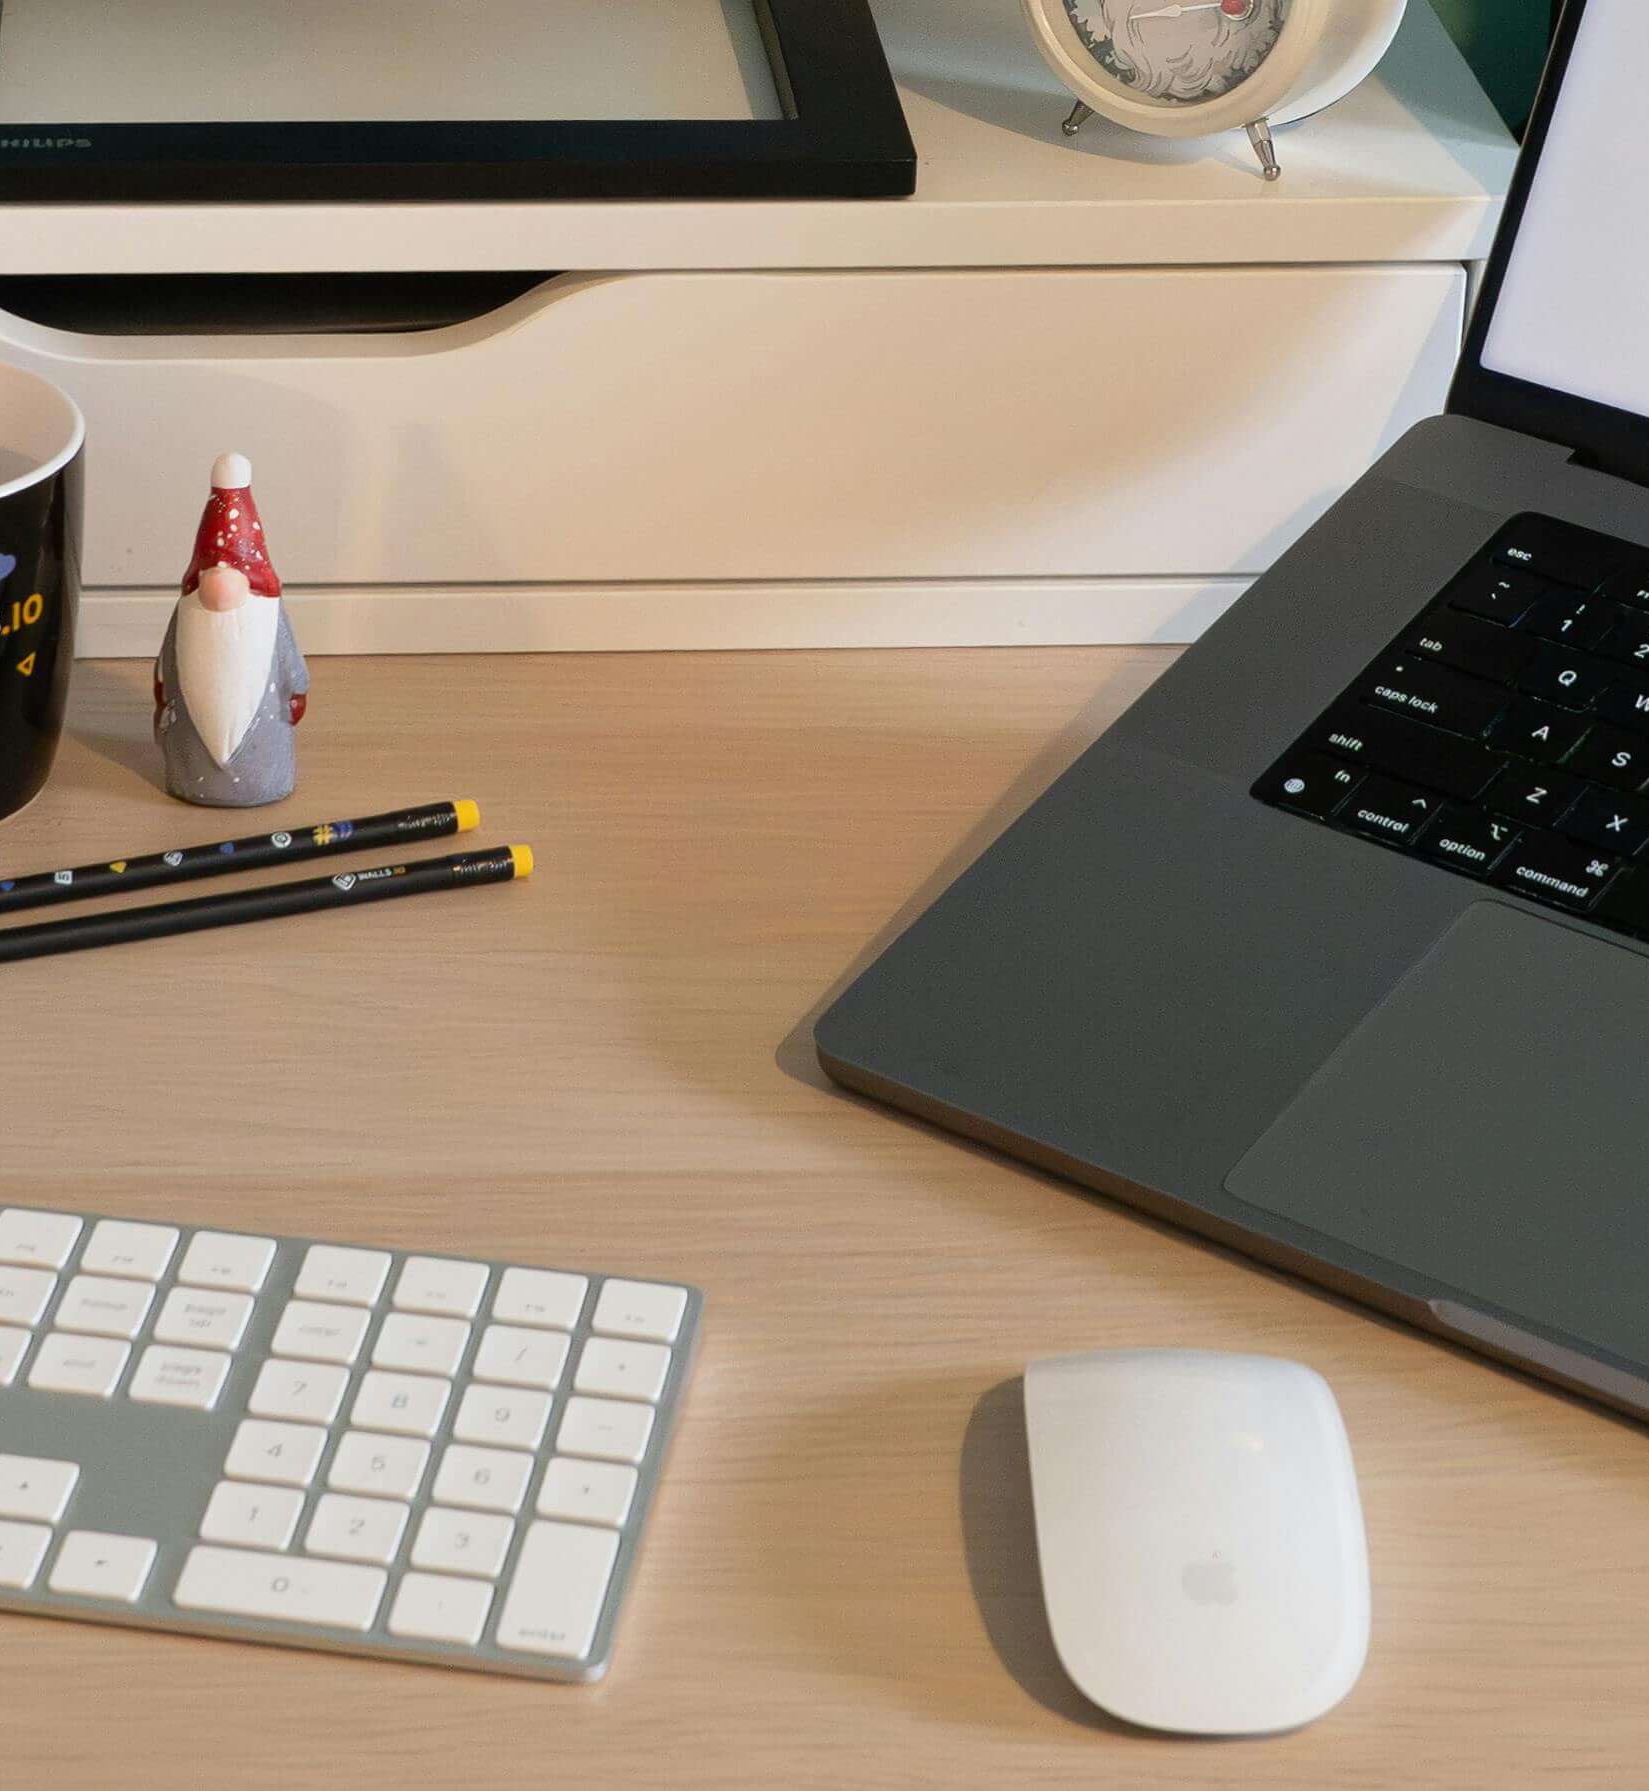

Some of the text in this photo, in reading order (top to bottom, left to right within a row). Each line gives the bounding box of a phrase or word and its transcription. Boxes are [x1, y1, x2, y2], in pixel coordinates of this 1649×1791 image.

[1507, 548, 1532, 561] esc
[1419, 637, 1443, 652] tab
[1374, 686, 1438, 713] caps lock
[1328, 733, 1363, 752] shift
[1334, 769, 1351, 783] fn
[1357, 809, 1410, 833] control
[1439, 838, 1486, 861] option
[1516, 866, 1589, 898] command
